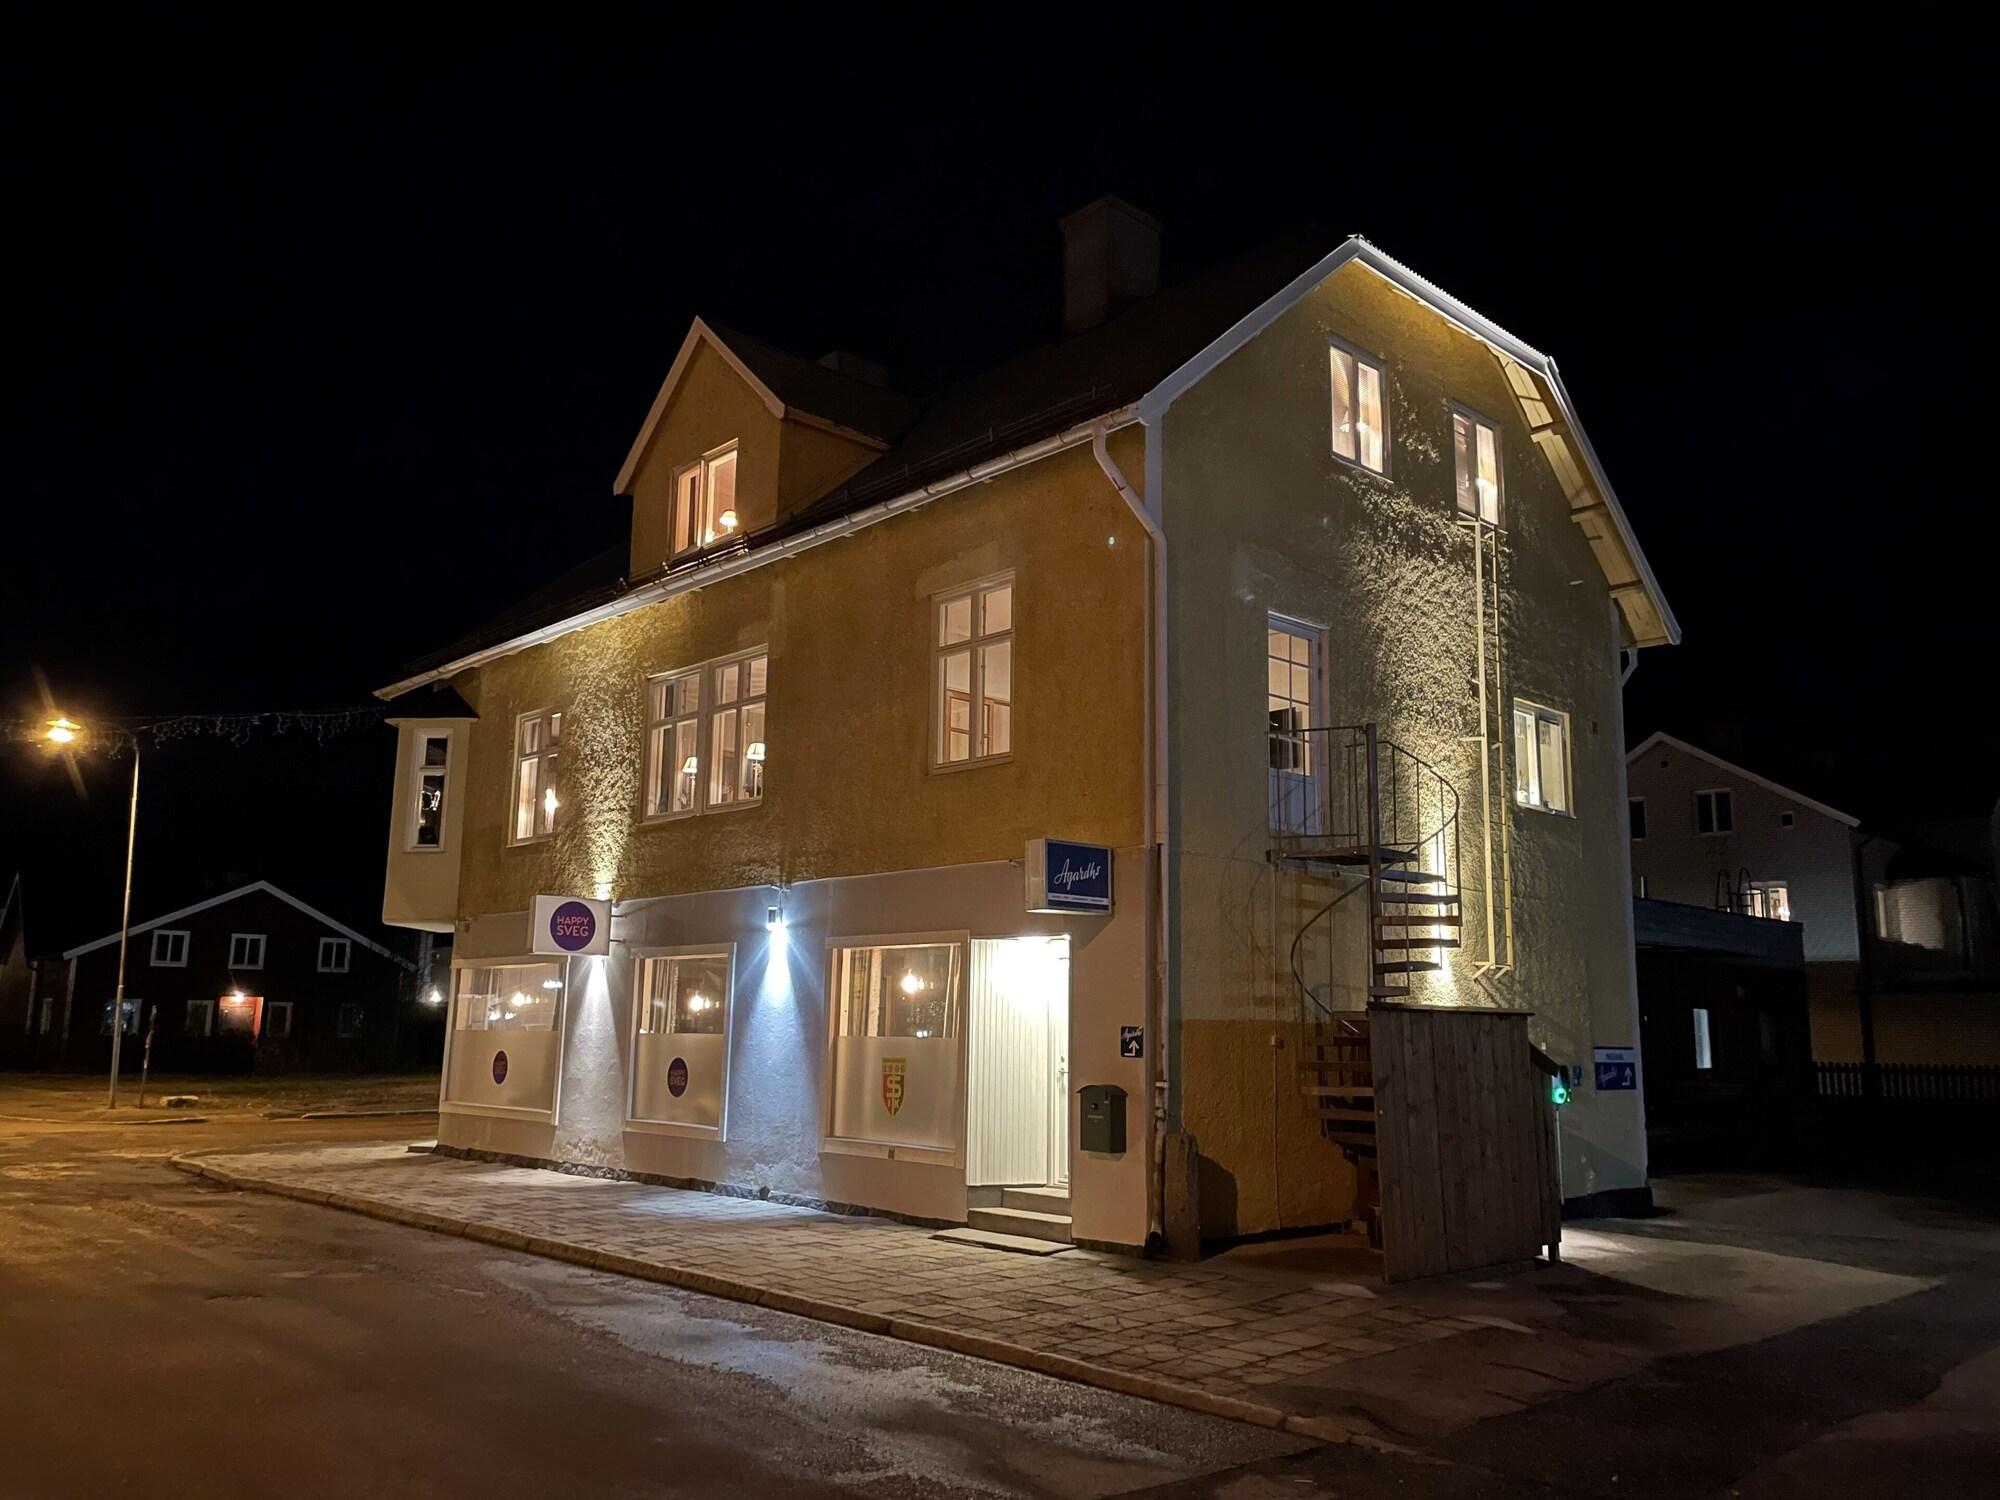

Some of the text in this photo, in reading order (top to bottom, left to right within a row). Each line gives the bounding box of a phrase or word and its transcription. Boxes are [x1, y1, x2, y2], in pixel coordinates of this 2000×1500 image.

[1054, 857, 1101, 891] Agardhs
[556, 915, 589, 926] HAPPY
[556, 925, 589, 937] SVEG
